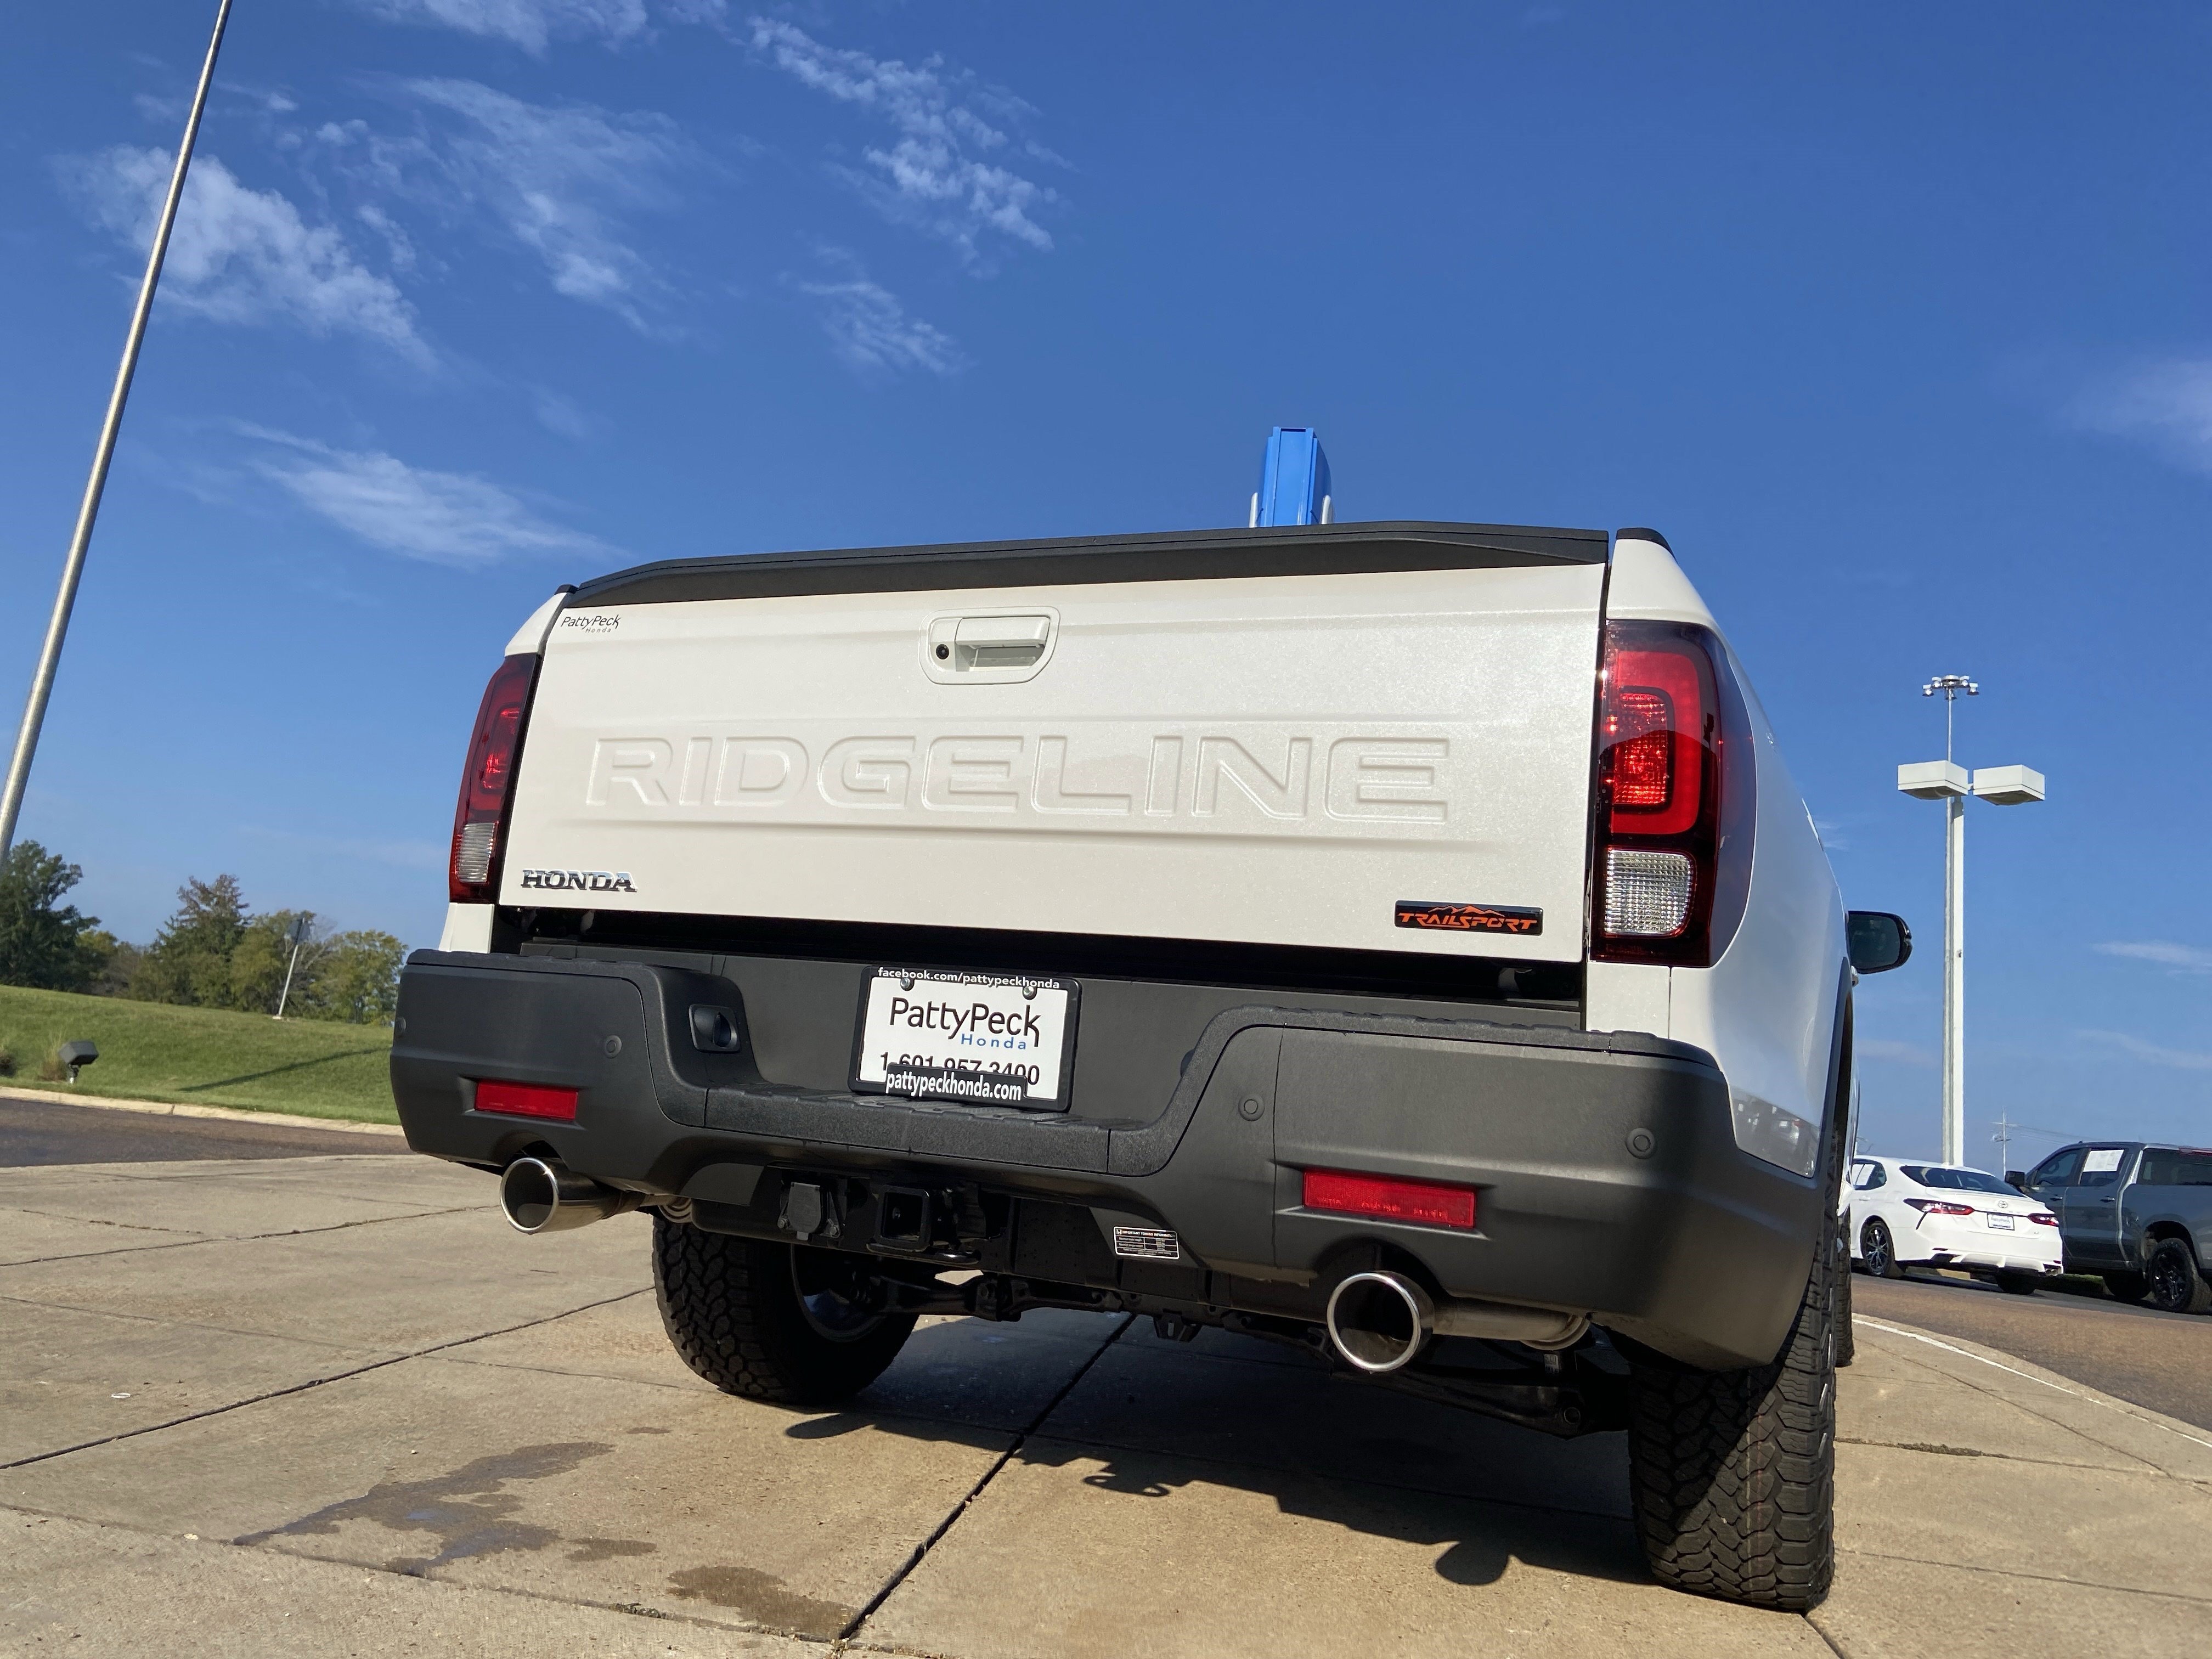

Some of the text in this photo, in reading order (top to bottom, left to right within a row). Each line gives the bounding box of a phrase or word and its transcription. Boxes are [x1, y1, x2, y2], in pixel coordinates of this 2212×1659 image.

[561, 614, 621, 630] PattyPeck
[586, 736, 1450, 825] RIDGELINE
[521, 868, 638, 893] HONDA
[1398, 912, 1538, 932] TRAILSPORT
[878, 967, 1060, 989] facebook.com/pattypeckhonda
[889, 996, 1042, 1047] PattyPeck
[961, 1033, 1026, 1050] Honda
[885, 1071, 1022, 1101] pattypeckhonda.com
